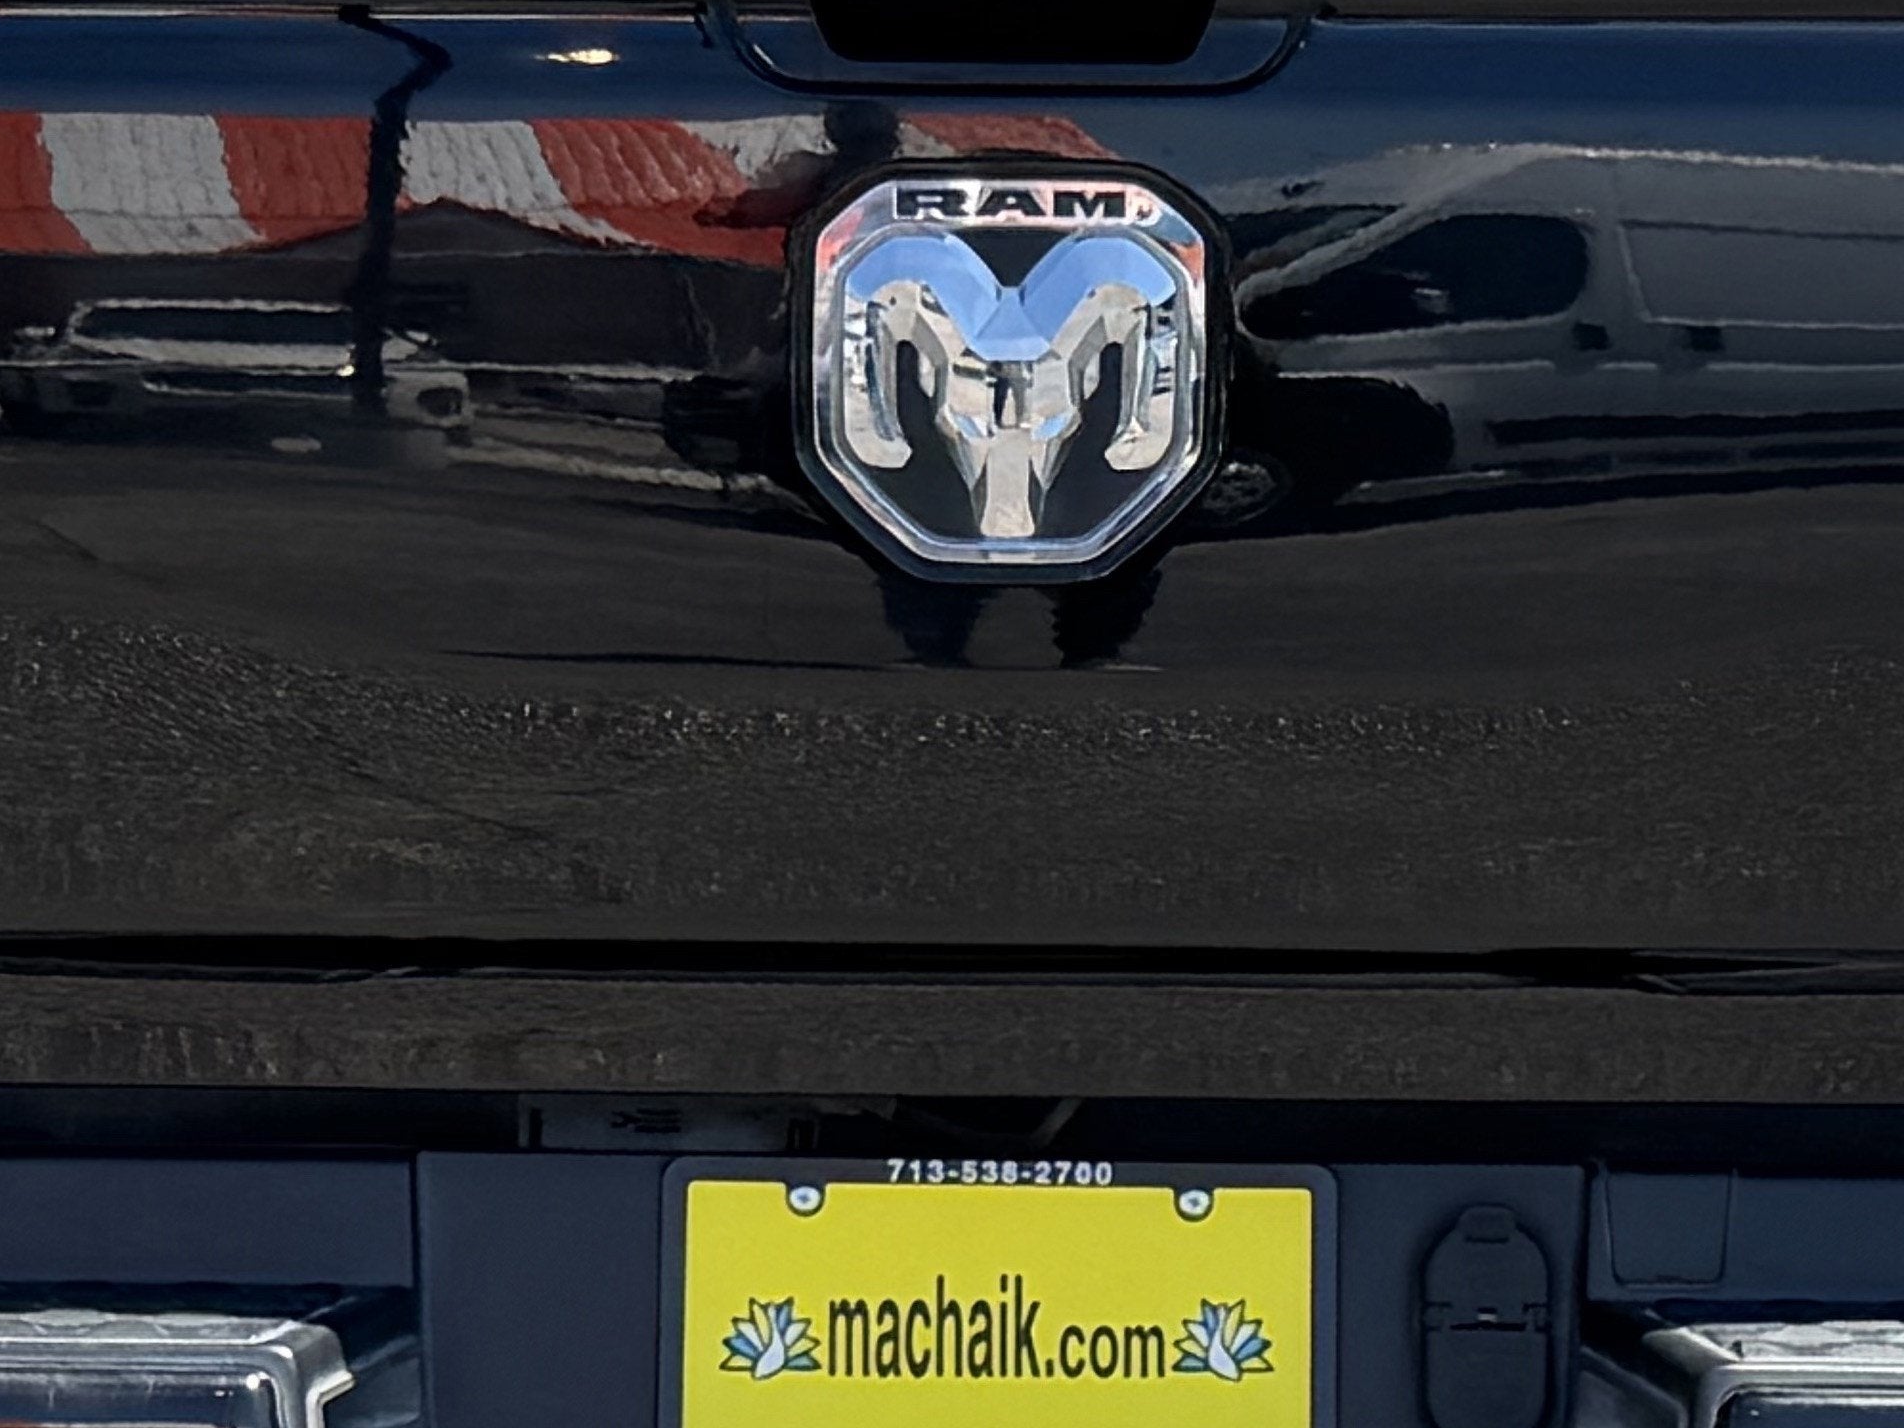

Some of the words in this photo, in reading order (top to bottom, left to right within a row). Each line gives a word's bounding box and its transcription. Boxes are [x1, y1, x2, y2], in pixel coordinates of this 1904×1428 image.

[894, 188, 1128, 220] RAM
[886, 1157, 1114, 1187] 713-538-2700
[827, 1273, 1167, 1379] machaik.com
